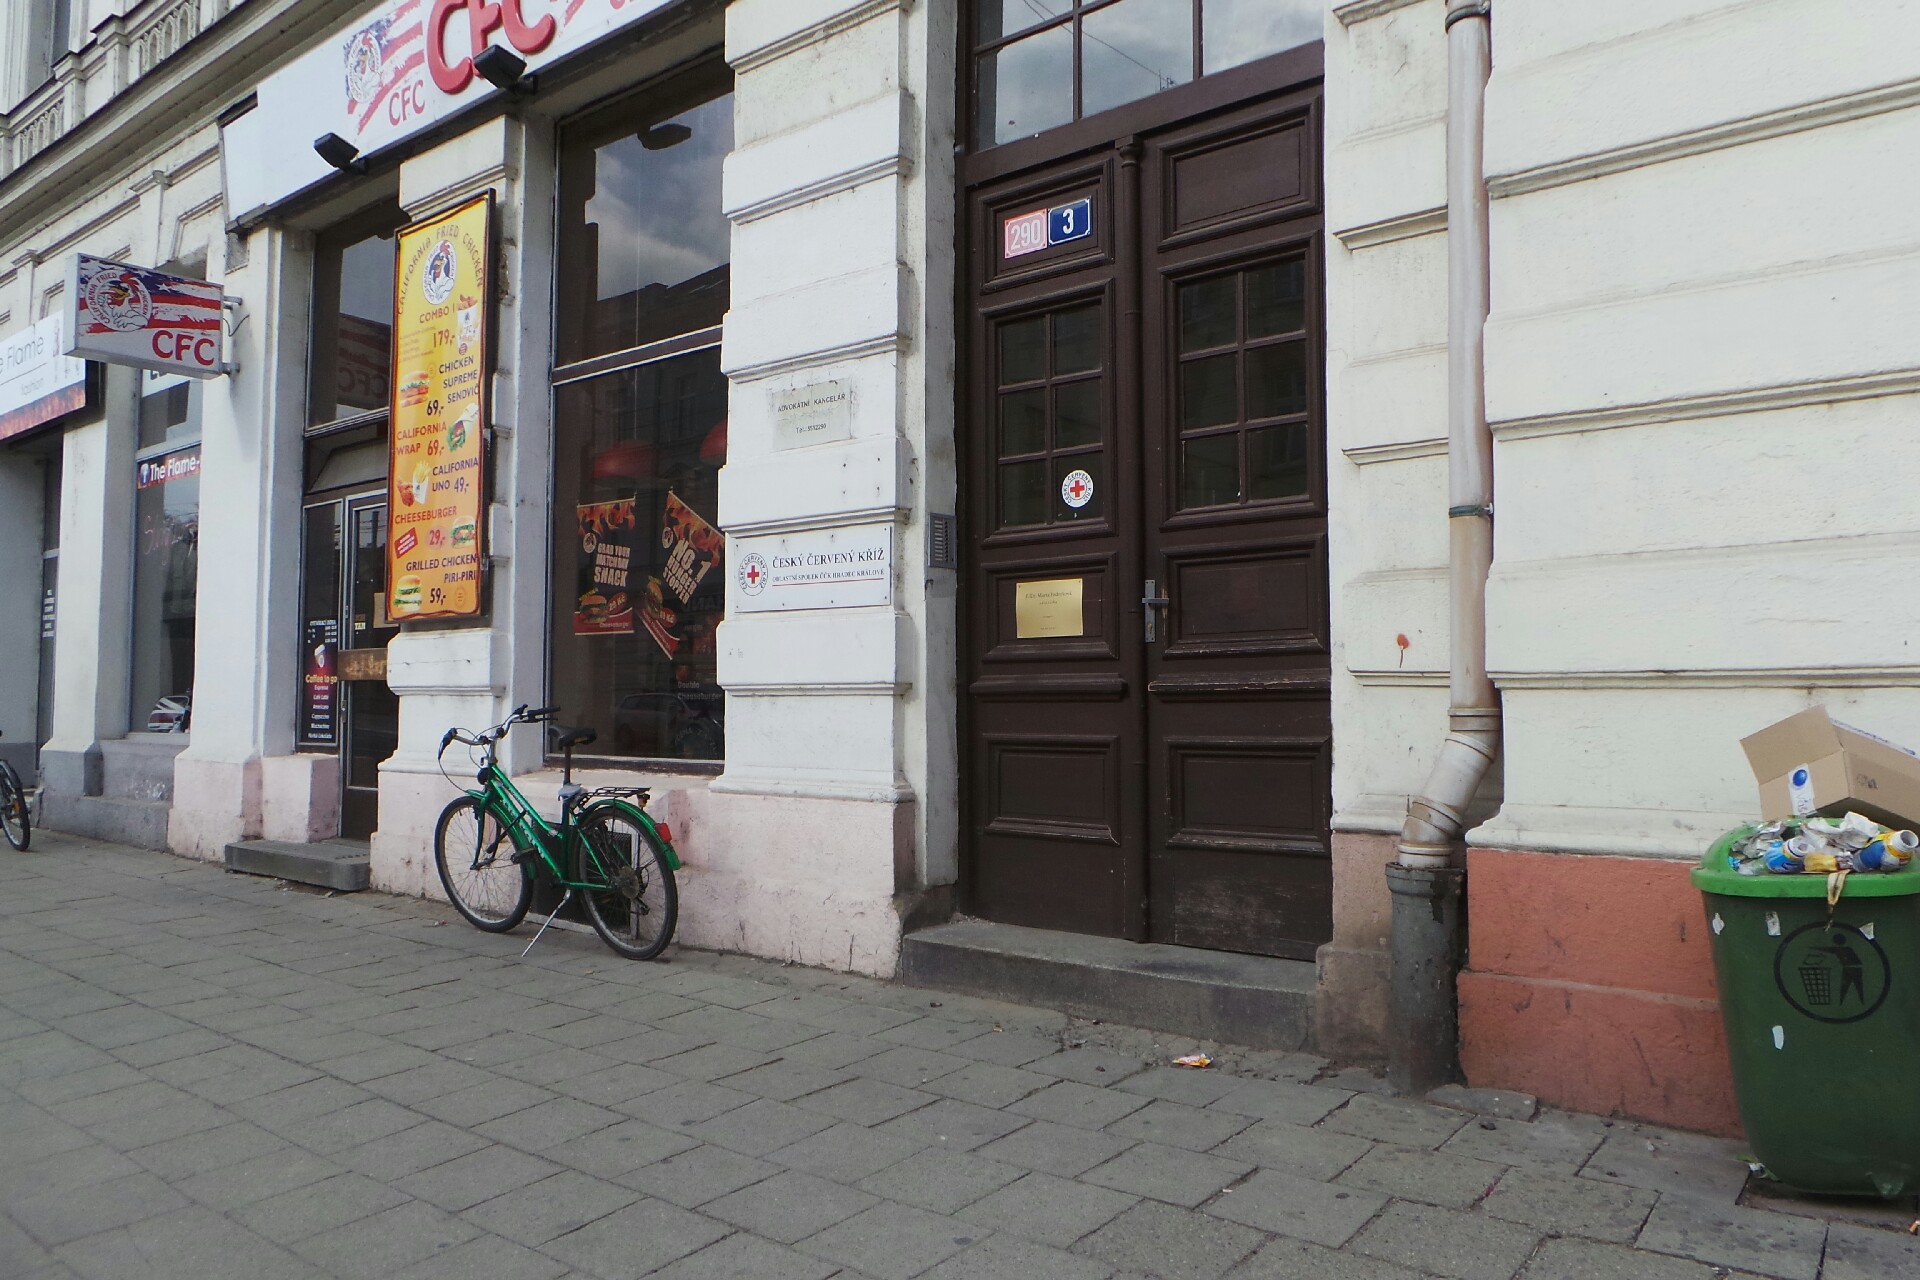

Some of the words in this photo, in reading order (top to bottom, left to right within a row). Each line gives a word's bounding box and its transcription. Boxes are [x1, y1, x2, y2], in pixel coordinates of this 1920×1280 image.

[389, 80, 426, 126] CFC
[1010, 219, 1042, 251] 290
[1062, 208, 1075, 235] 3
[96, 271, 118, 284] FRIED
[397, 238, 432, 316] CALIFORNIA
[436, 224, 460, 239] FRIED
[462, 232, 484, 289] CHICKEN
[87, 283, 110, 325] CALIFORNIA
[419, 306, 450, 324] COMBO
[7, 335, 45, 370] Flame
[152, 330, 216, 366] CFC
[438, 355, 475, 374] CHICKEN
[443, 369, 478, 389] SUPREME
[426, 399, 444, 416] 69,-
[397, 422, 447, 441] CALIFORNIA
[396, 442, 421, 456] WRAP
[426, 440, 445, 457] 69,-
[150, 463, 166, 481] The
[432, 457, 479, 477] CALIFORNIA
[432, 479, 451, 493] UNO
[454, 477, 470, 494] 49,-
[394, 506, 458, 525] CHEESEBURGER
[429, 529, 446, 547] 29,-
[597, 543, 615, 555] GRAB
[614, 546, 631, 559] YOUR
[671, 537, 697, 576] NO.
[695, 561, 713, 584] 1
[771, 553, 805, 569] ČESKÝ
[806, 549, 856, 566] ČERVENÝ
[857, 547, 885, 562] KŘÍŽ
[406, 556, 440, 572] GRILLED
[441, 552, 478, 569] CHICKEN
[444, 569, 477, 585] PIRI-PIRI
[594, 567, 628, 588] SNACK
[667, 555, 698, 595] HUNGER
[832, 569, 856, 579] HRADEC
[856, 567, 885, 577] KRÁLOVÉ
[430, 587, 447, 606] 59,-
[662, 568, 691, 606] STOPPER
[305, 674, 324, 684] Coffee
[324, 674, 330, 684] to
[330, 676, 338, 685] go
